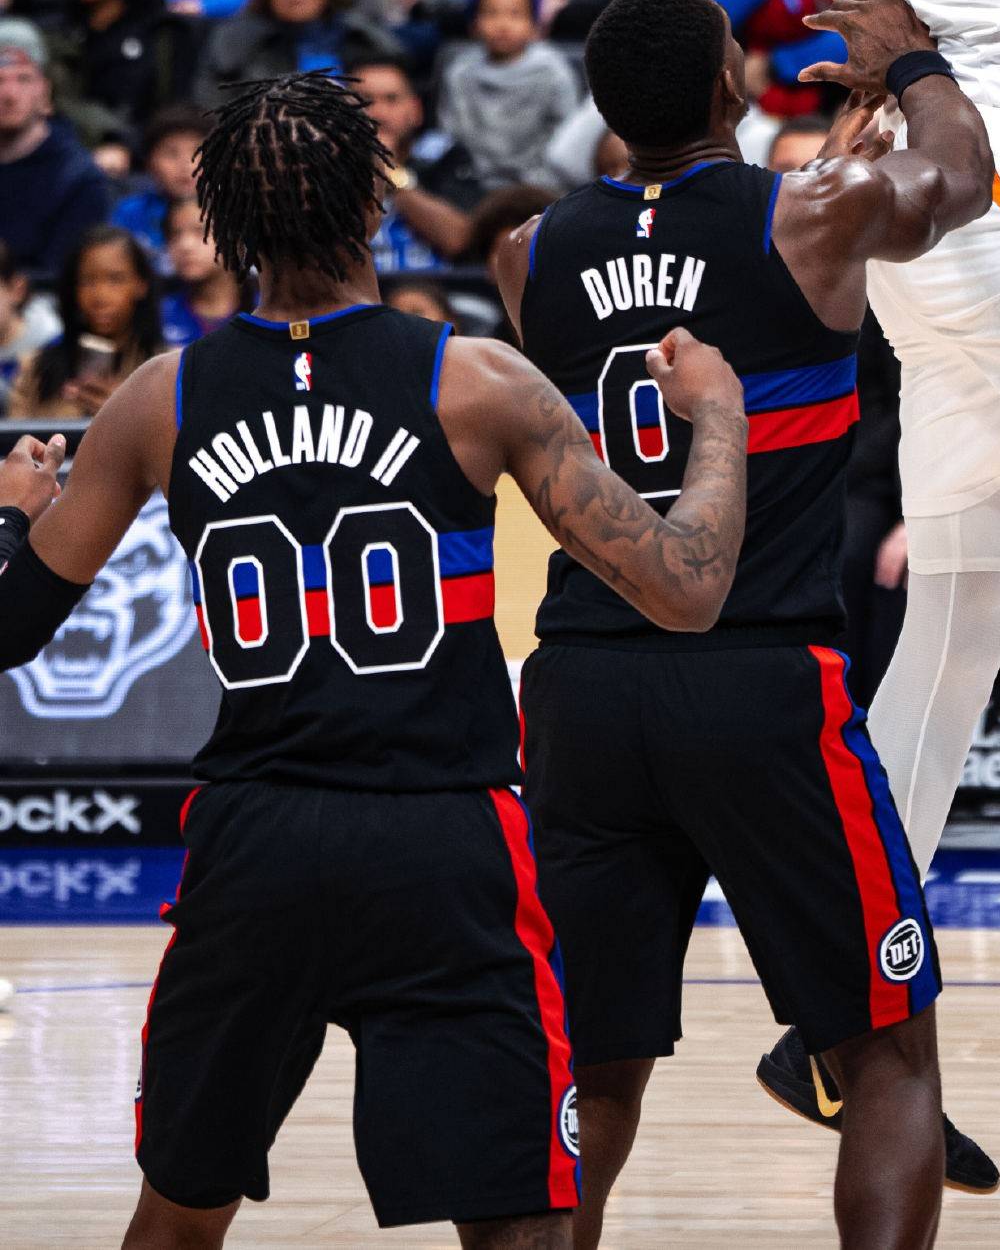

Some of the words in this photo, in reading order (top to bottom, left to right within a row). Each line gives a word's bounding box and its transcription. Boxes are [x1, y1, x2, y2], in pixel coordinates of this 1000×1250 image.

[580, 253, 706, 321] DUREN
[188, 404, 374, 503] HOLLAND
[370, 426, 421, 487] II
[598, 343, 692, 500] 0
[194, 501, 445, 690] 00
[889, 933, 918, 966] DET
